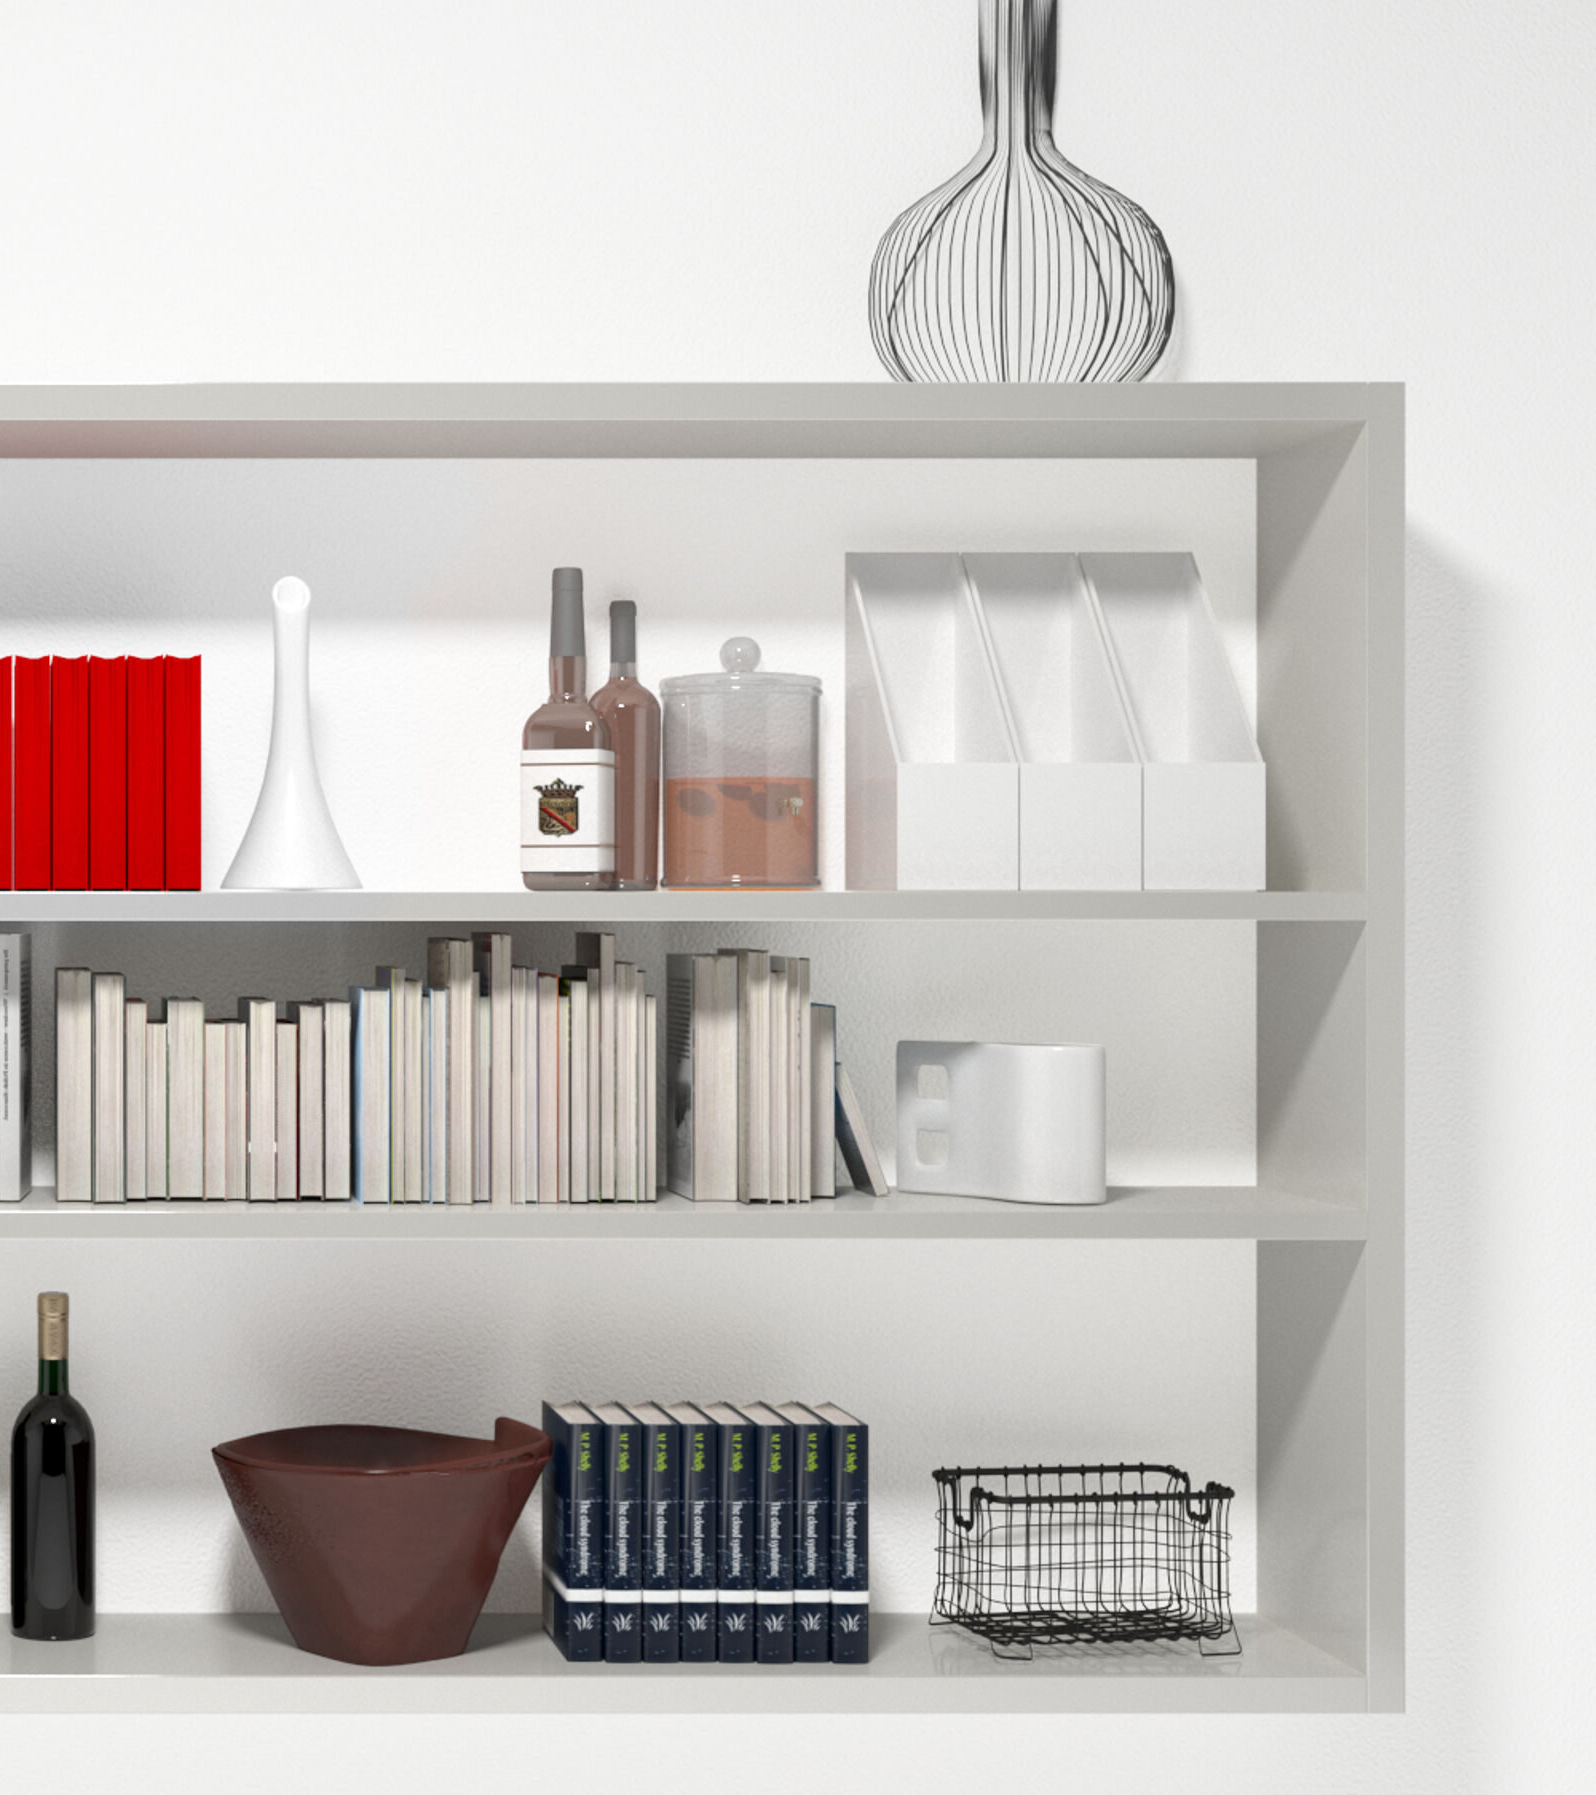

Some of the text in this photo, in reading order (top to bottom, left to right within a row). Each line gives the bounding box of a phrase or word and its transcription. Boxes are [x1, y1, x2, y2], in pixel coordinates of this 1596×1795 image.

[578, 1500, 592, 1575] The cloud syndrome
[617, 1501, 630, 1576] The cloud syndrome
[654, 1501, 668, 1576] The cloud syndrome
[692, 1501, 705, 1576] The cloud syndrome
[730, 1501, 744, 1576] The cloud syndrome
[768, 1502, 782, 1577] The cloud syndrome
[805, 1501, 819, 1576] The cloud syndrome
[844, 1502, 858, 1577] The cloud syndrome
